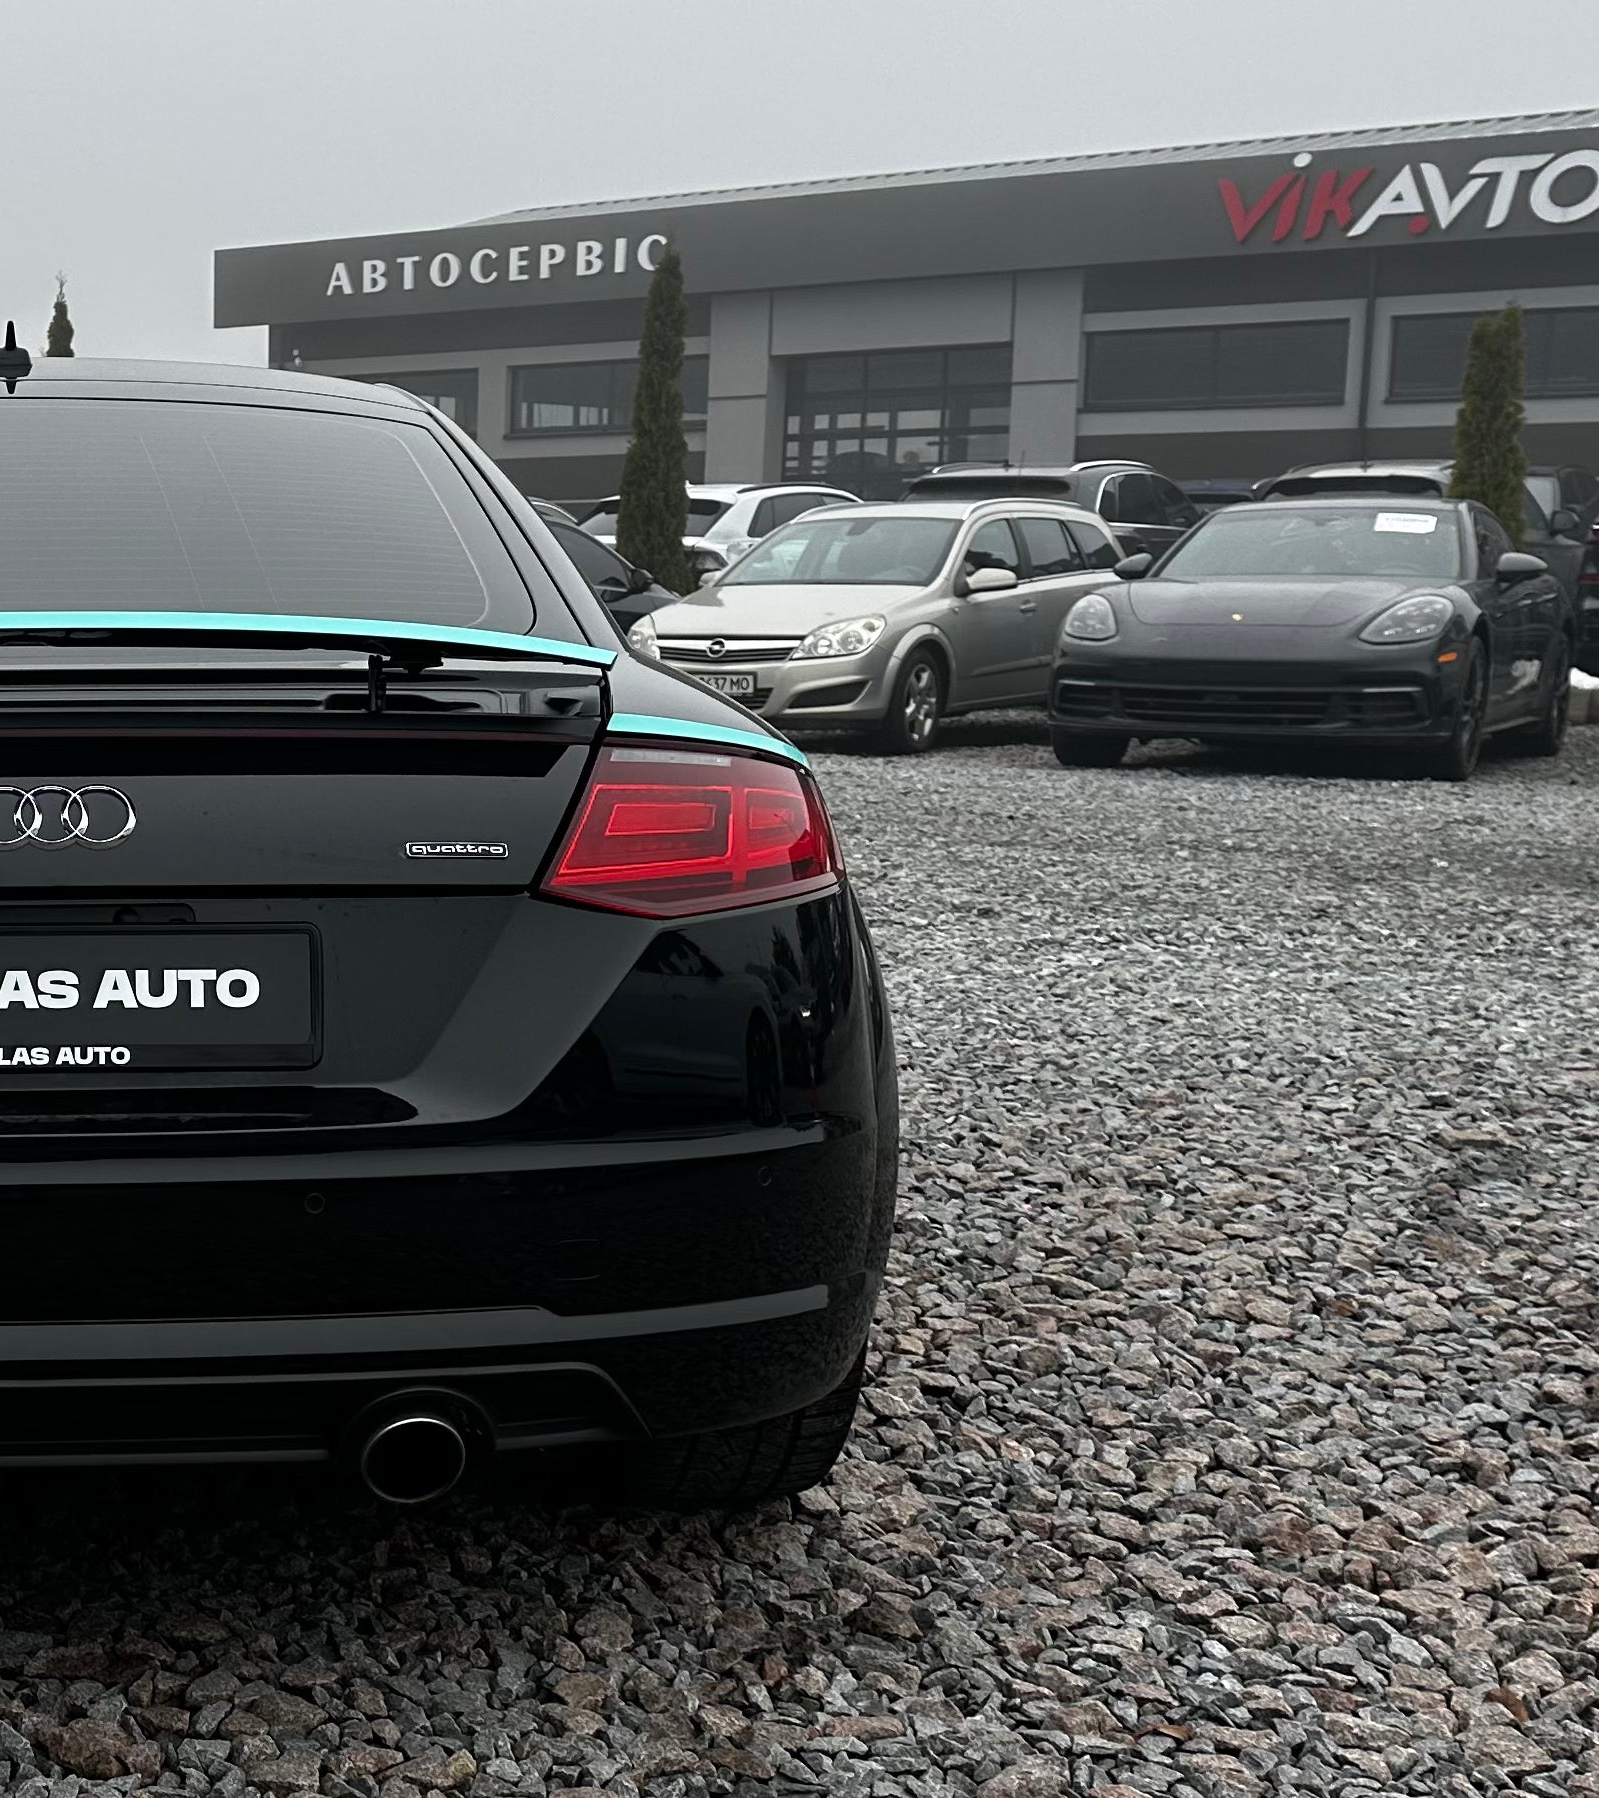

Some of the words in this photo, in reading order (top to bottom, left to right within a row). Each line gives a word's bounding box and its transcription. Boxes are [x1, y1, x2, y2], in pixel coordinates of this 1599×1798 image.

[326, 234, 668, 296] АВТОСЕРВІС
[411, 844, 504, 855] quattro
[92, 969, 260, 1009] AUTO
[55, 1046, 131, 1066] AUTO
